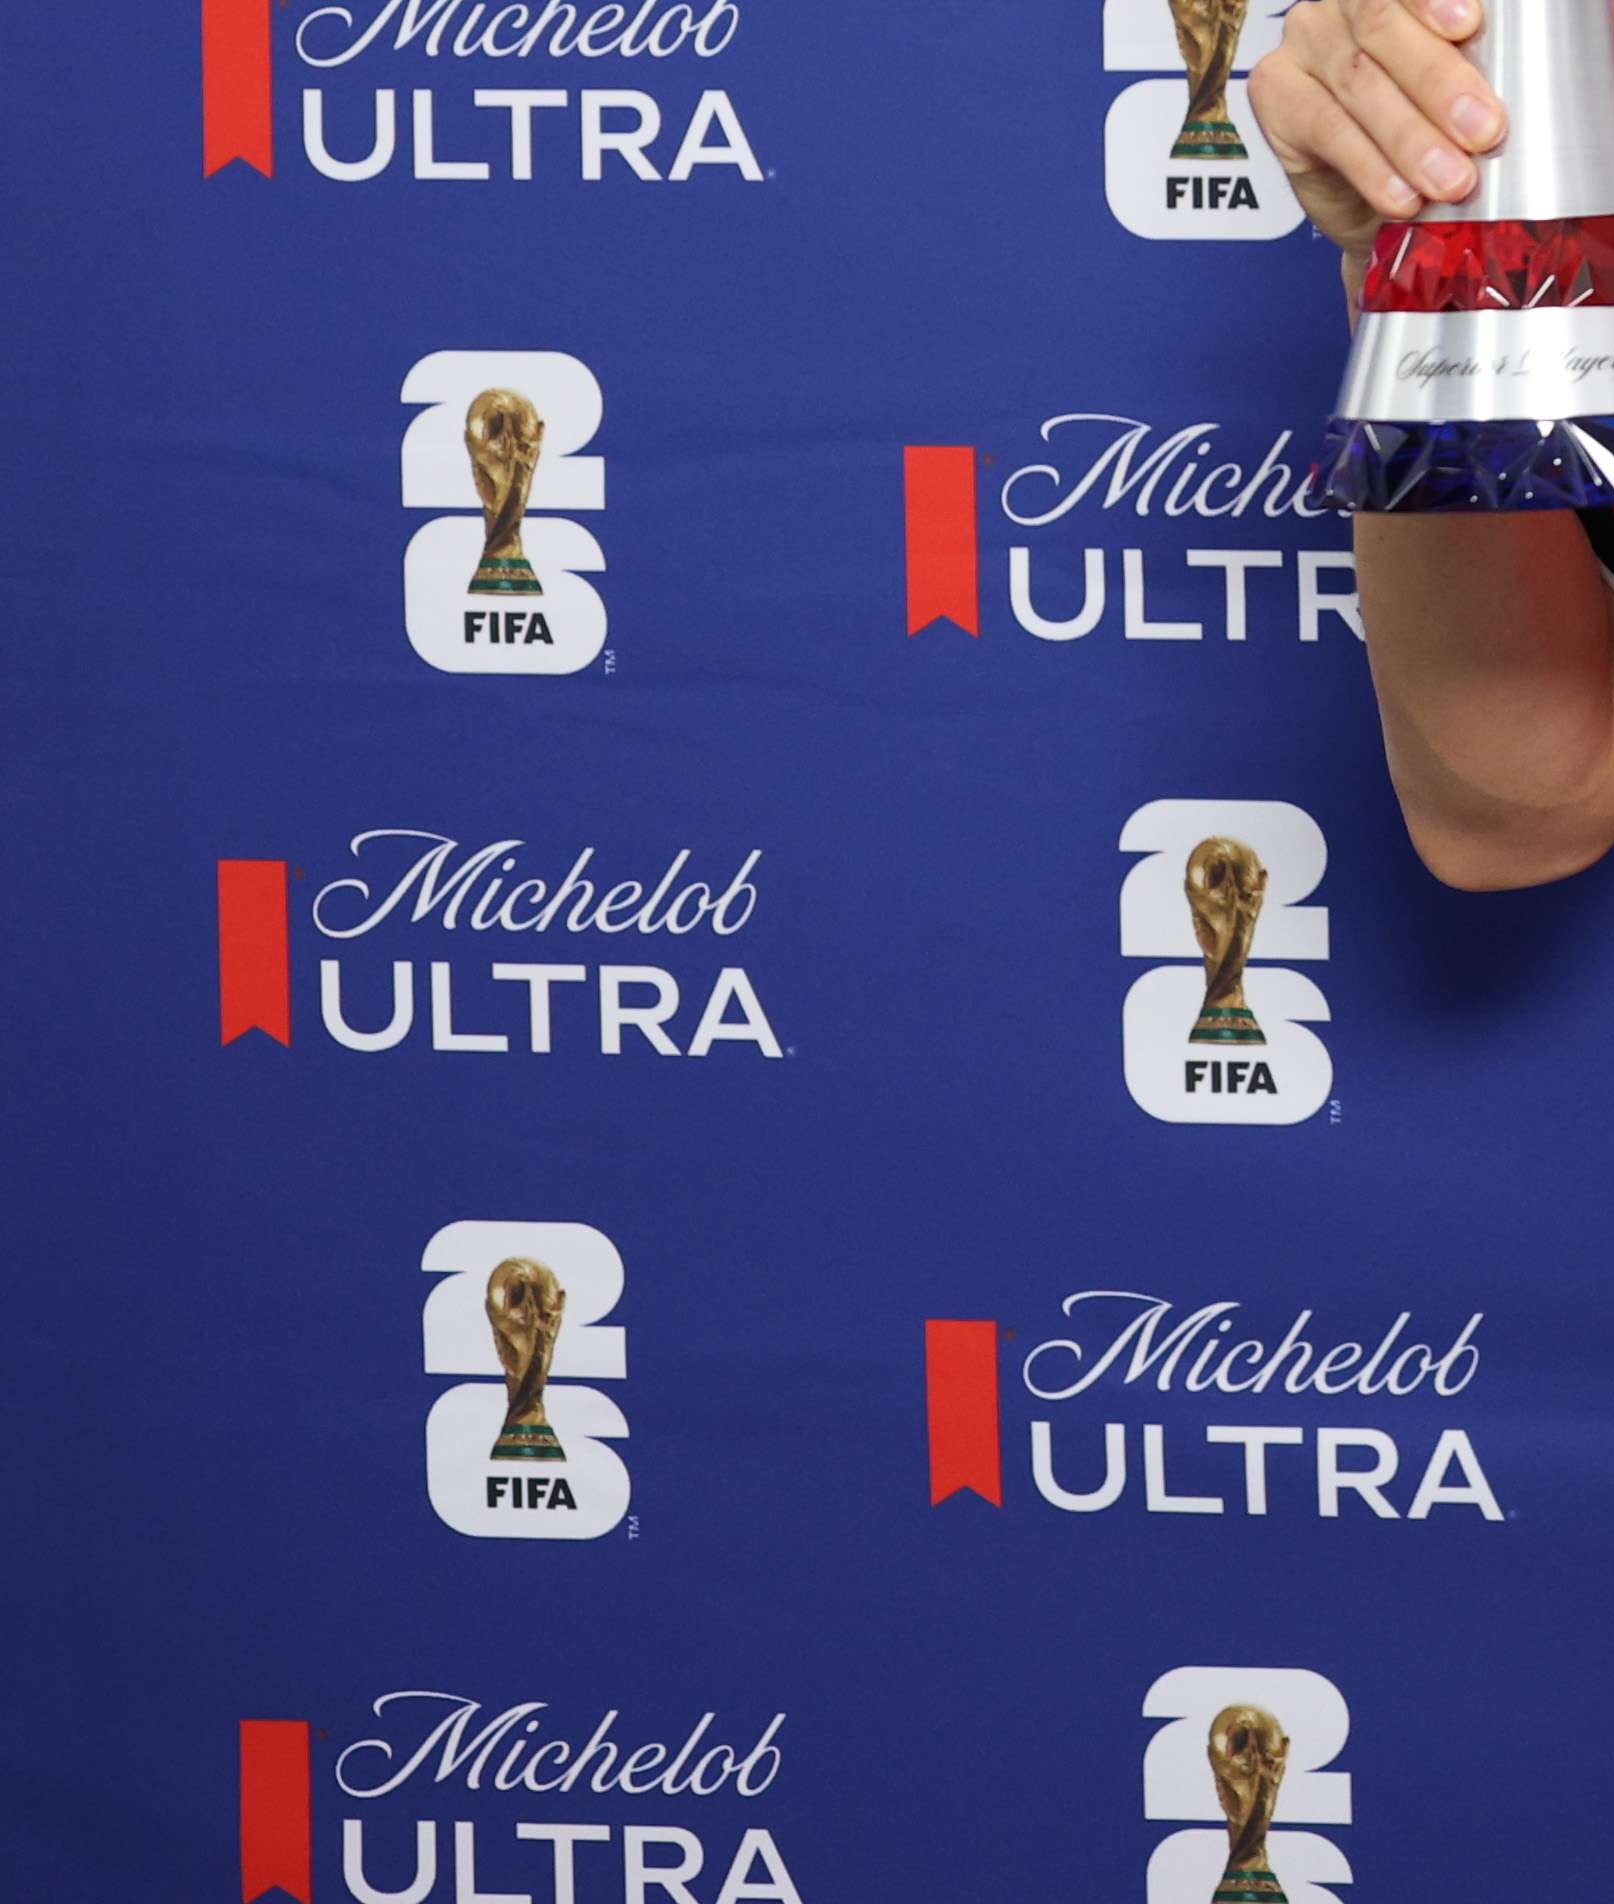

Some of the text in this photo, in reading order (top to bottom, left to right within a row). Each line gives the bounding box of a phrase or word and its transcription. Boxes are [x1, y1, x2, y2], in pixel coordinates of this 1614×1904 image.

[303, 89, 764, 182] ULTRA
[1166, 176, 1260, 210] FIFA
[464, 611, 554, 645] FIFA
[1009, 546, 1367, 642] ULTR
[313, 829, 762, 938] Michelob
[320, 959, 783, 1058] ULTRA
[1185, 1060, 1278, 1095] FIFA
[1023, 1291, 1483, 1400] Michelob
[486, 1476, 577, 1510] FIFA
[1031, 1421, 1505, 1521] ULTRA
[336, 1691, 786, 1798] Michelob
[343, 1819, 803, 1904] ULTRA
